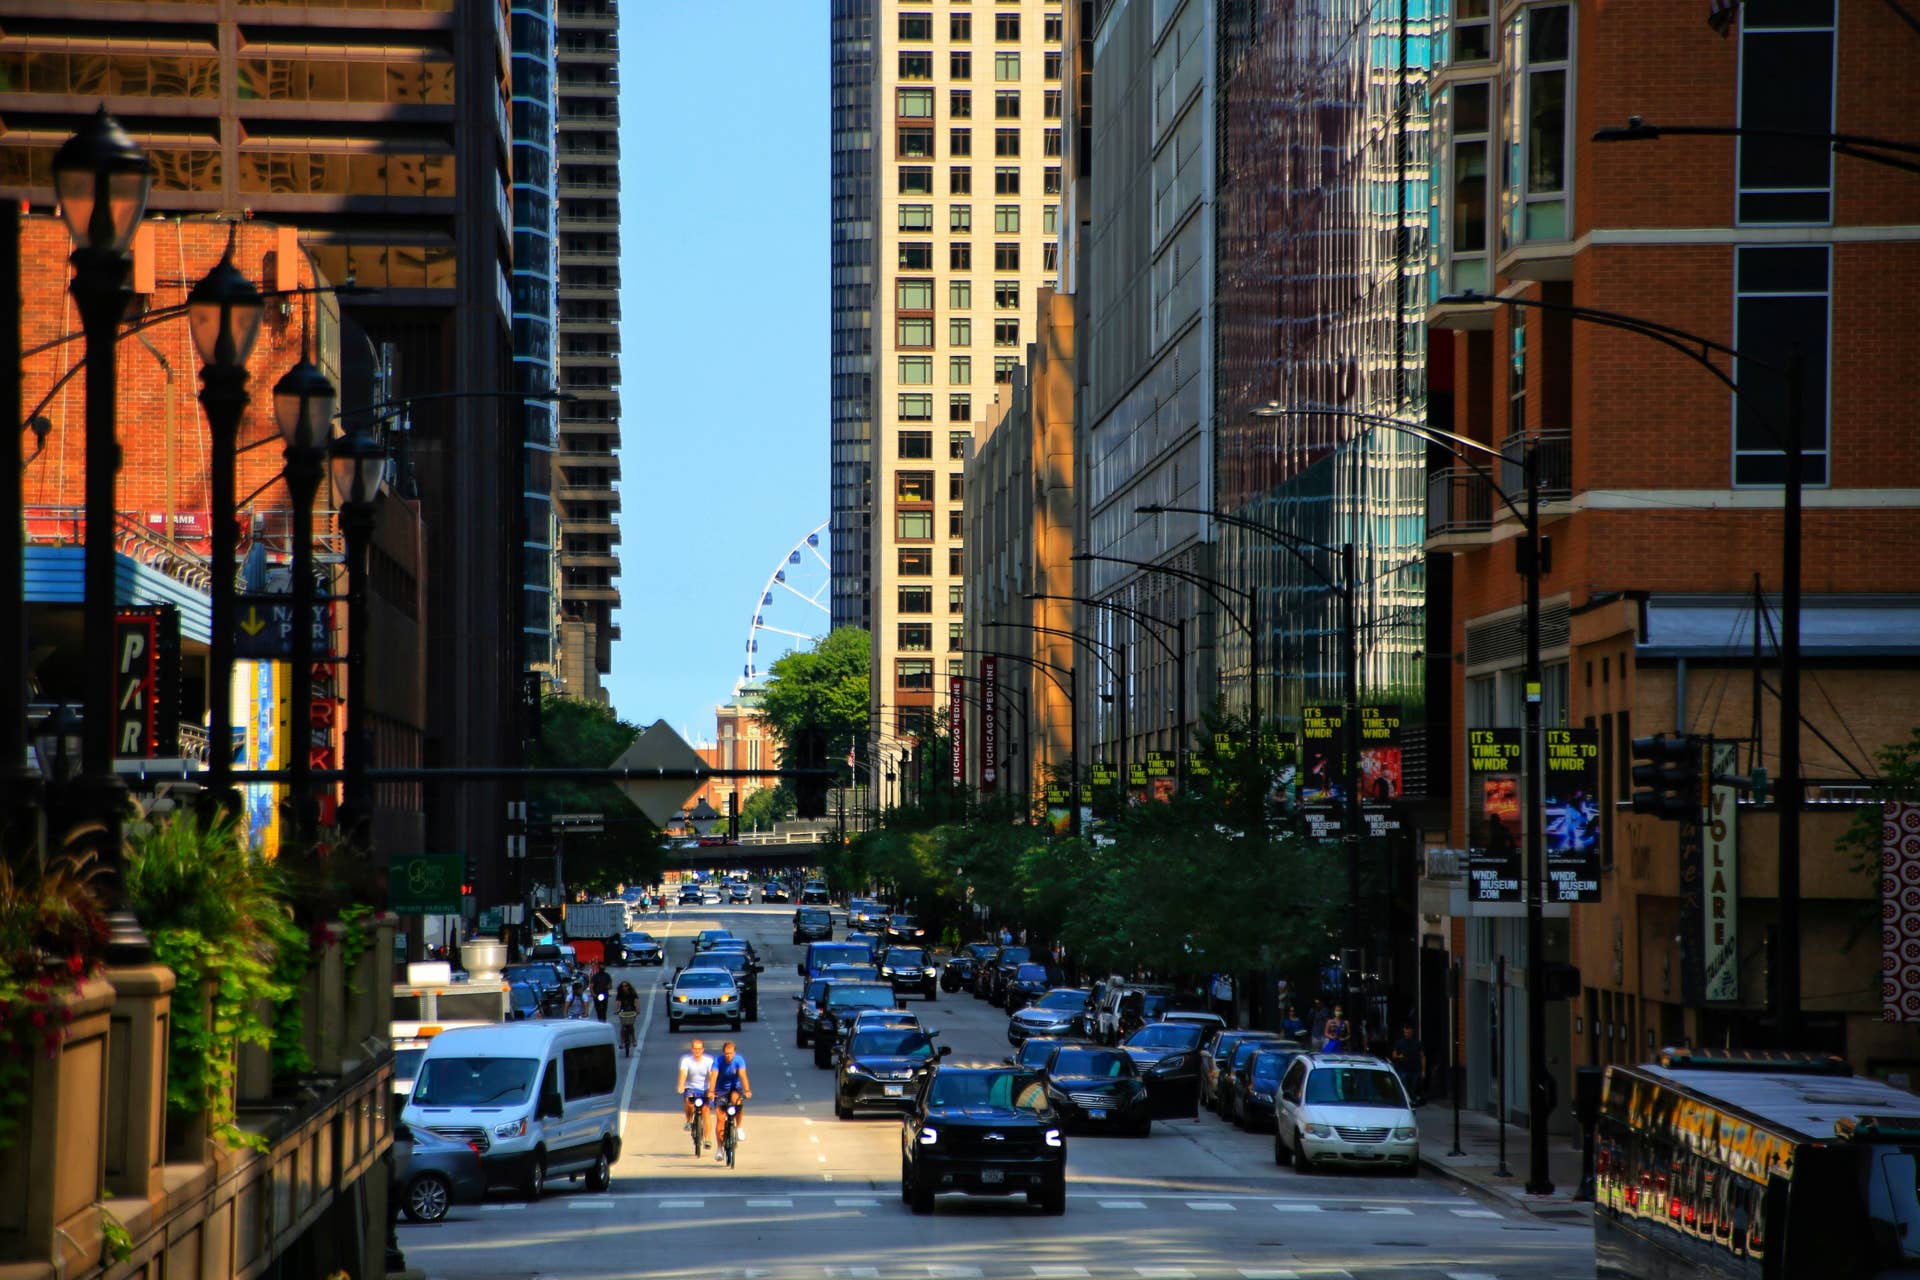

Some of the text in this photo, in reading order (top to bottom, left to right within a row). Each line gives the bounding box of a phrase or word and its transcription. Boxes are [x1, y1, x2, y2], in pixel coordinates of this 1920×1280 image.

[166, 514, 195, 524] AMR
[272, 604, 325, 622] NY
[280, 623, 325, 640] PR
[986, 663, 994, 766] UCHICAGO MEDICINE
[1304, 708, 1321, 718] IT'S
[1362, 708, 1380, 718] IT'S
[1304, 718, 1342, 728] TIME TO
[1362, 718, 1400, 728] TIME TO
[1305, 728, 1333, 739] WNDR
[1362, 728, 1391, 739] WNDR
[1471, 731, 1494, 743] IT'S
[1547, 731, 1571, 743] IT'S
[1147, 752, 1160, 760] IT'S
[1472, 745, 1520, 757] TIME TO
[1548, 745, 1597, 757] TIME TO
[1148, 760, 1175, 768] TIME TO
[1472, 759, 1509, 771] WNDR
[1549, 759, 1585, 771] WNDR
[1305, 814, 1325, 822] WNDR
[1363, 814, 1385, 822] WNDR
[1311, 822, 1341, 830] MUSEUM
[1370, 822, 1400, 830] MUSEUM
[1711, 793, 1726, 945] VOLARE
[1472, 870, 1498, 880] WNDR
[1550, 871, 1577, 881] WNDR
[1480, 880, 1518, 890] MUSEUM
[1559, 881, 1597, 891] MUSEUM
